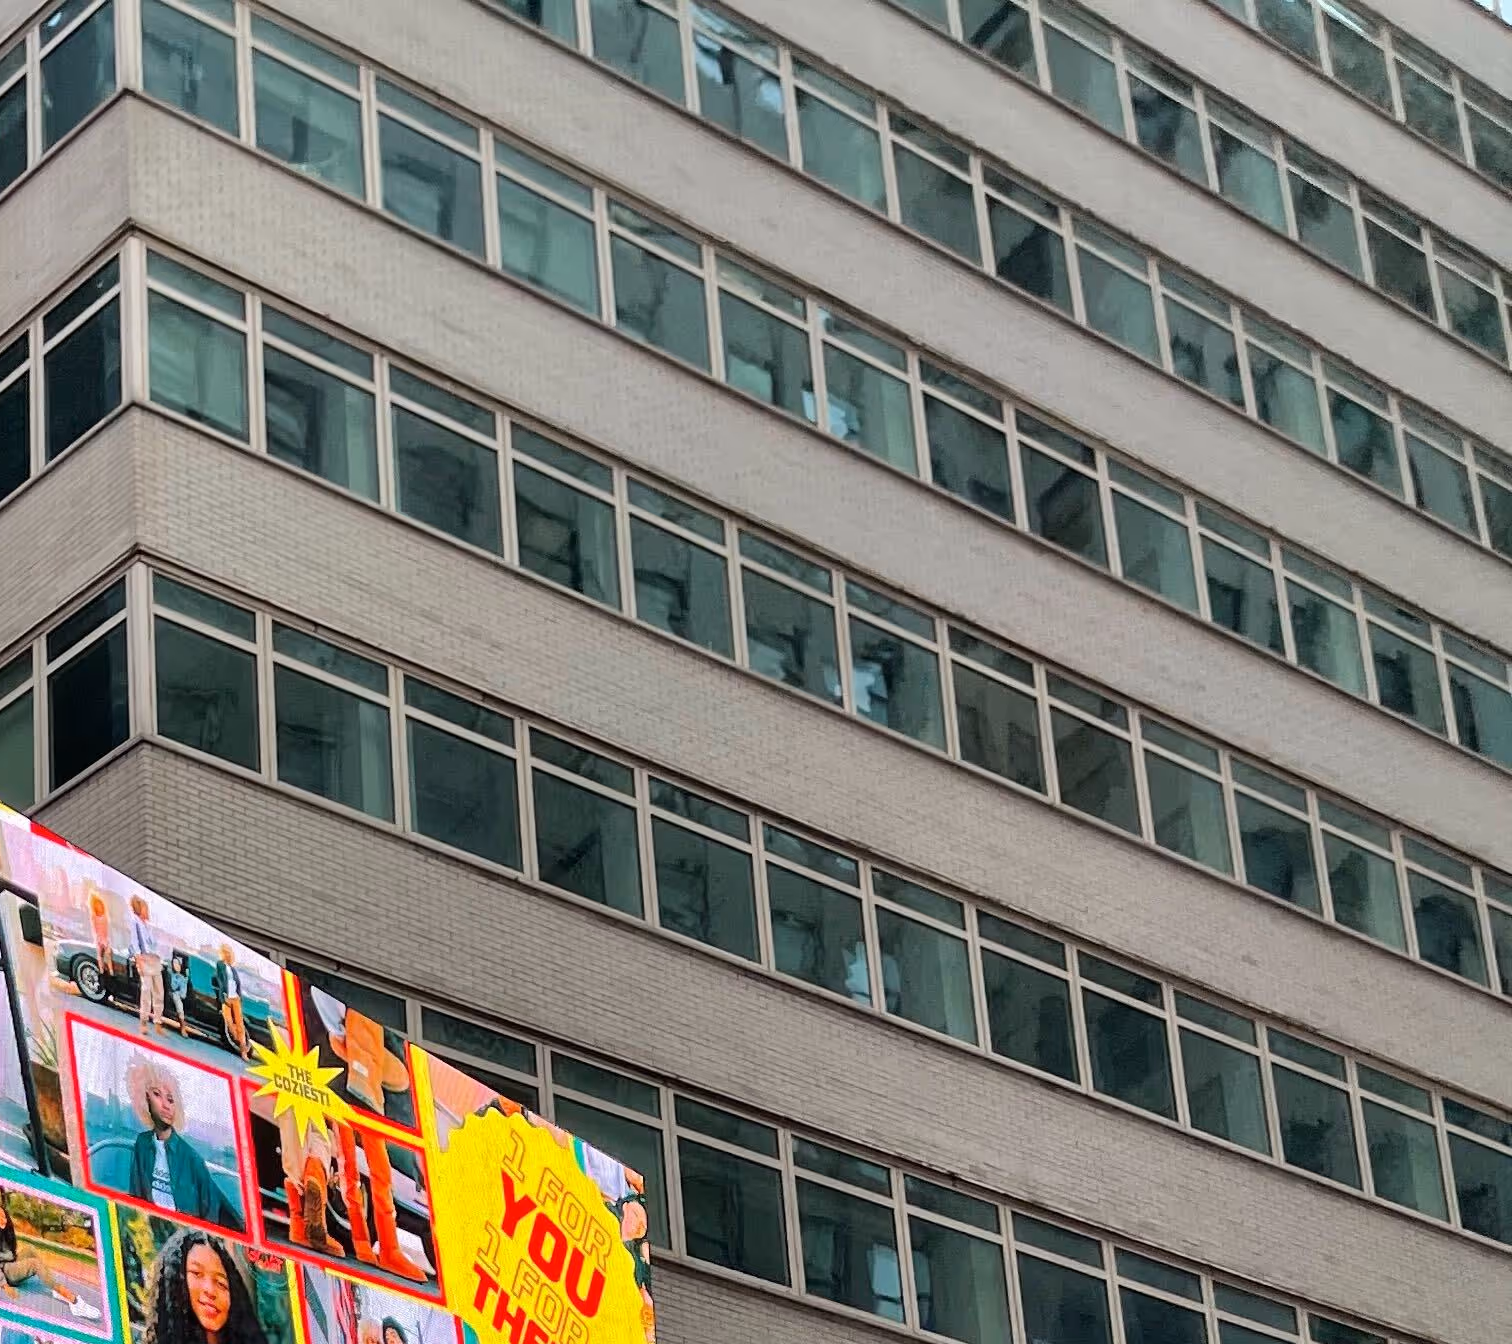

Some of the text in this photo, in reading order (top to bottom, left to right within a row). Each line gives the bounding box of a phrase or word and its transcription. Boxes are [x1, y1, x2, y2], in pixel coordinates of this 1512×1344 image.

[287, 1063, 312, 1085] THE
[478, 1220, 500, 1276] 1
[501, 1168, 606, 1317] YOU
[503, 1129, 612, 1272] 1 FOR
